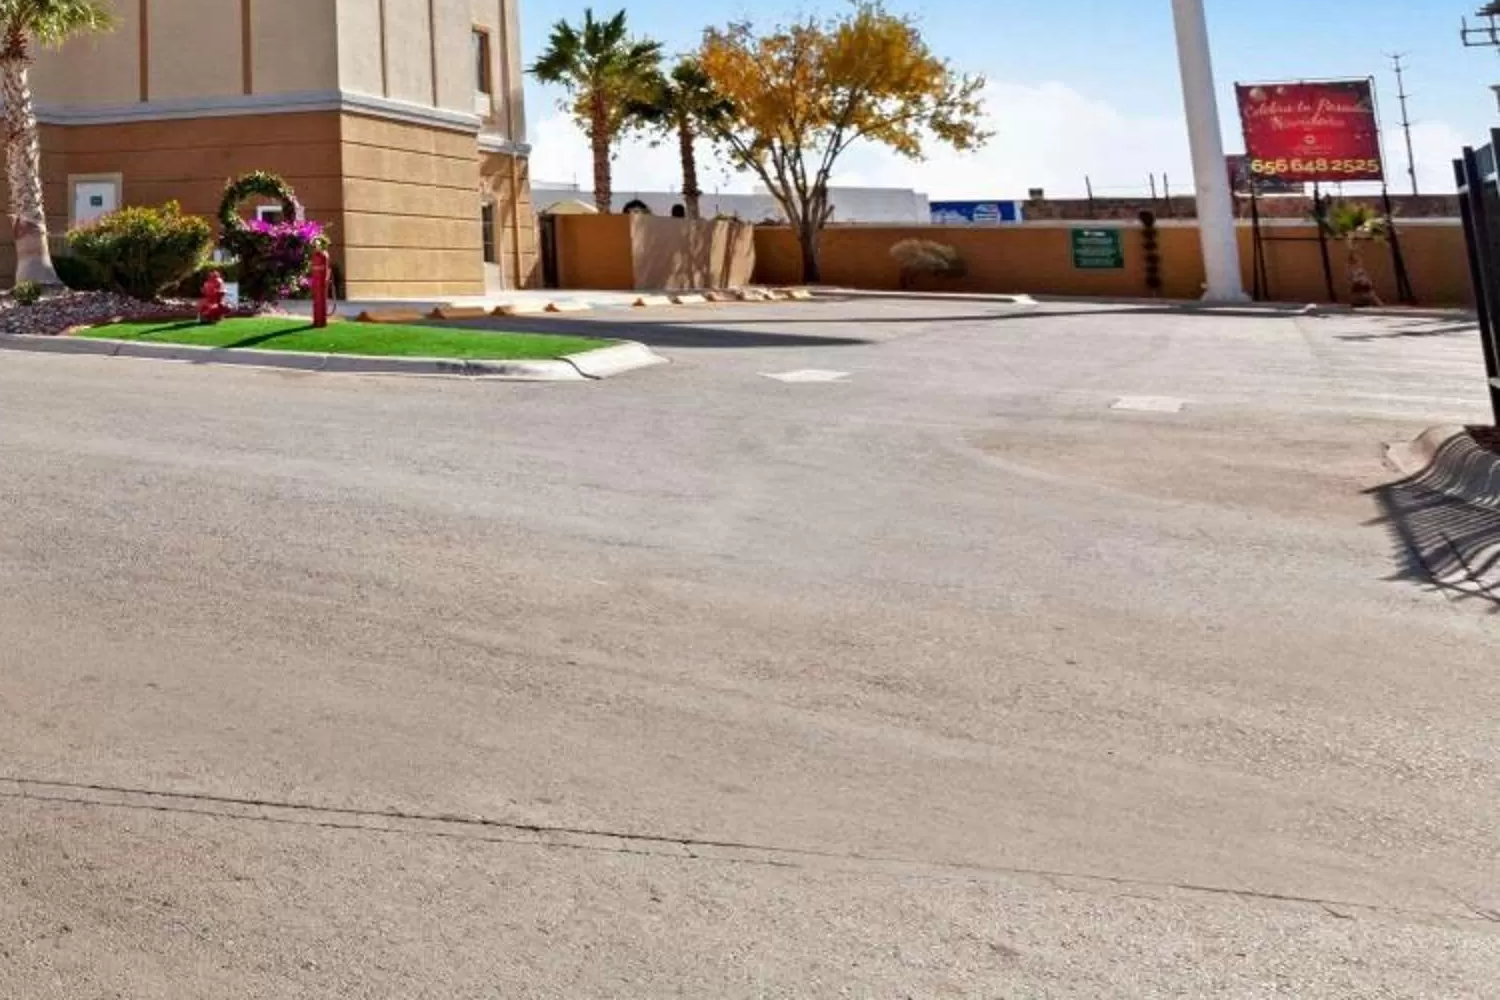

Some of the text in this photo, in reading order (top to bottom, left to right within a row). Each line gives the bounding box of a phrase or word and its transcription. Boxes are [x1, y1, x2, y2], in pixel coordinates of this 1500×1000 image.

[1251, 158, 1379, 175] 656 648 2525
